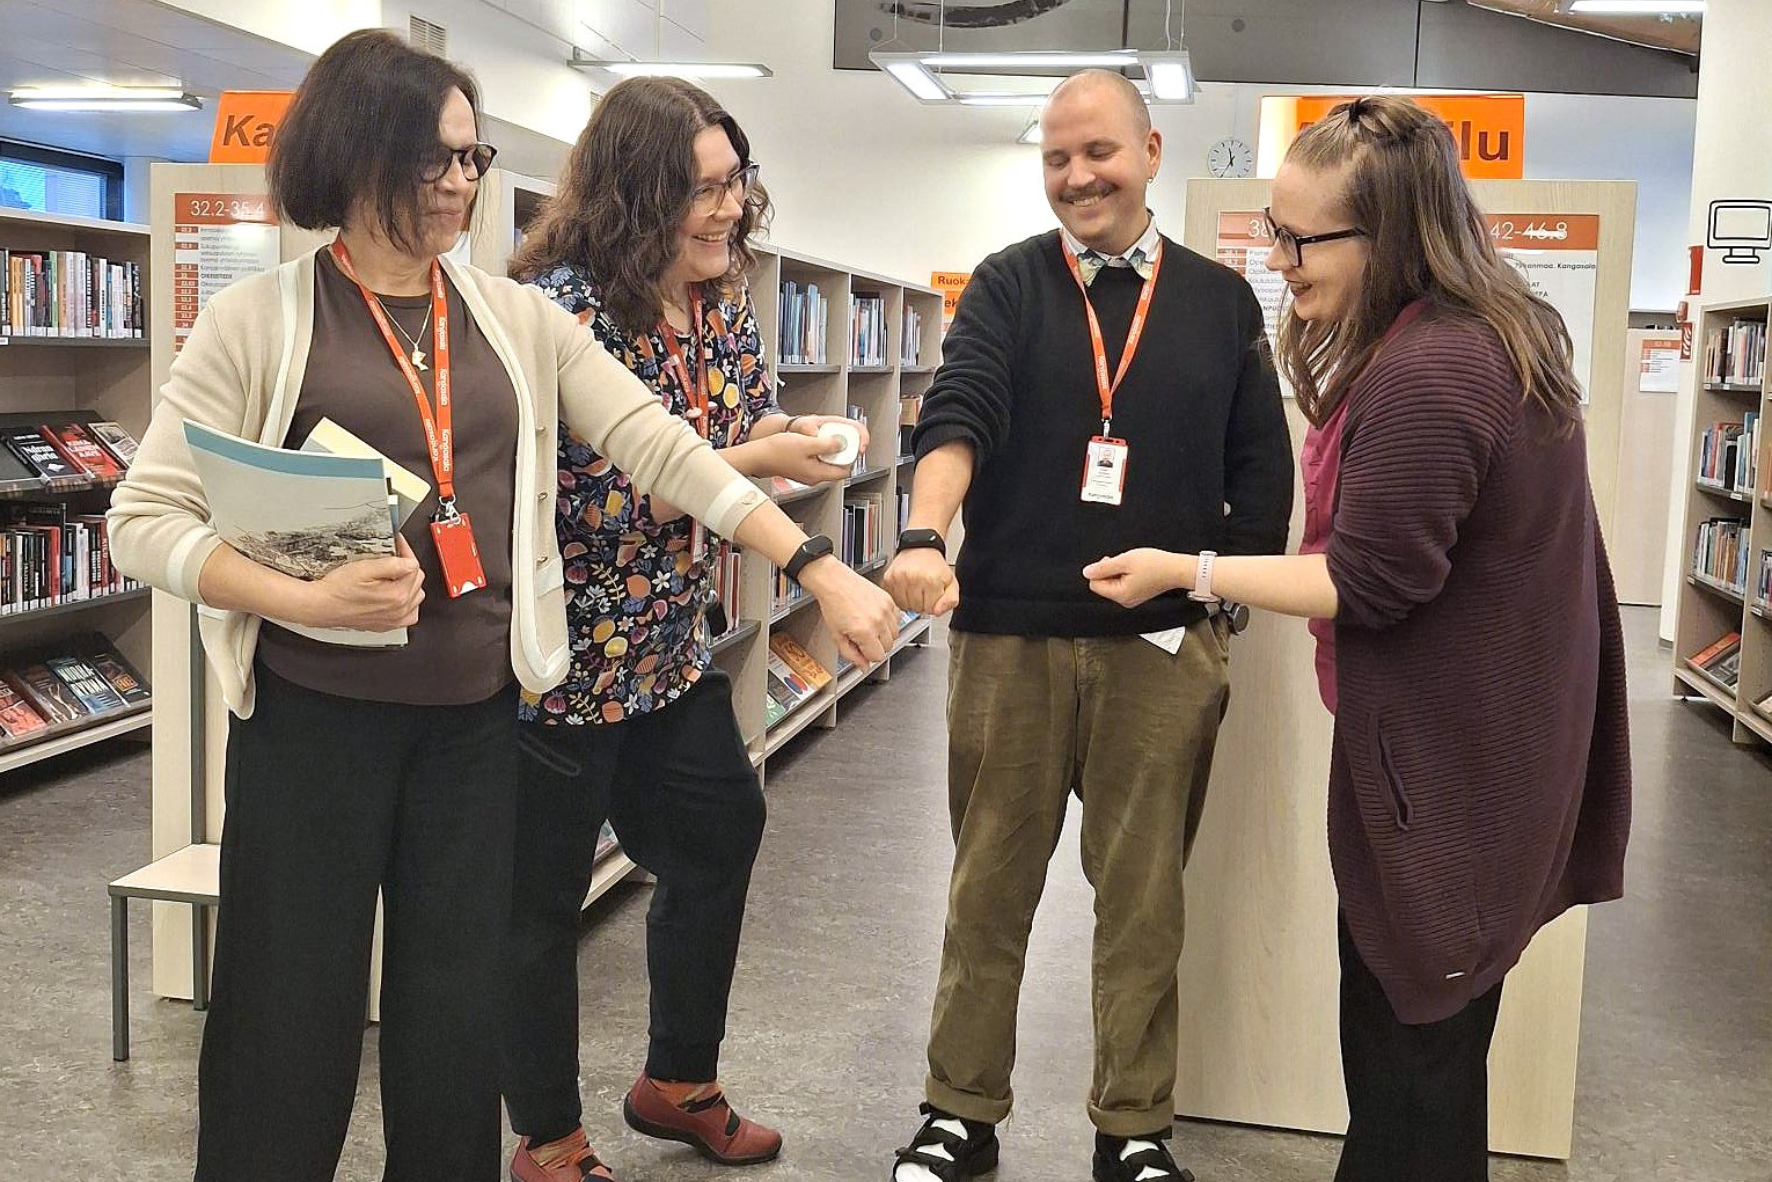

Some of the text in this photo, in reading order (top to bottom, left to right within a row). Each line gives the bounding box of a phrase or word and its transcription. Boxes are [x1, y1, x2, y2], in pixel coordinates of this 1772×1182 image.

[1557, 262, 1596, 271] Kangasala
[438, 368, 449, 406] Kangasala
[440, 428, 450, 472] Kangasala
